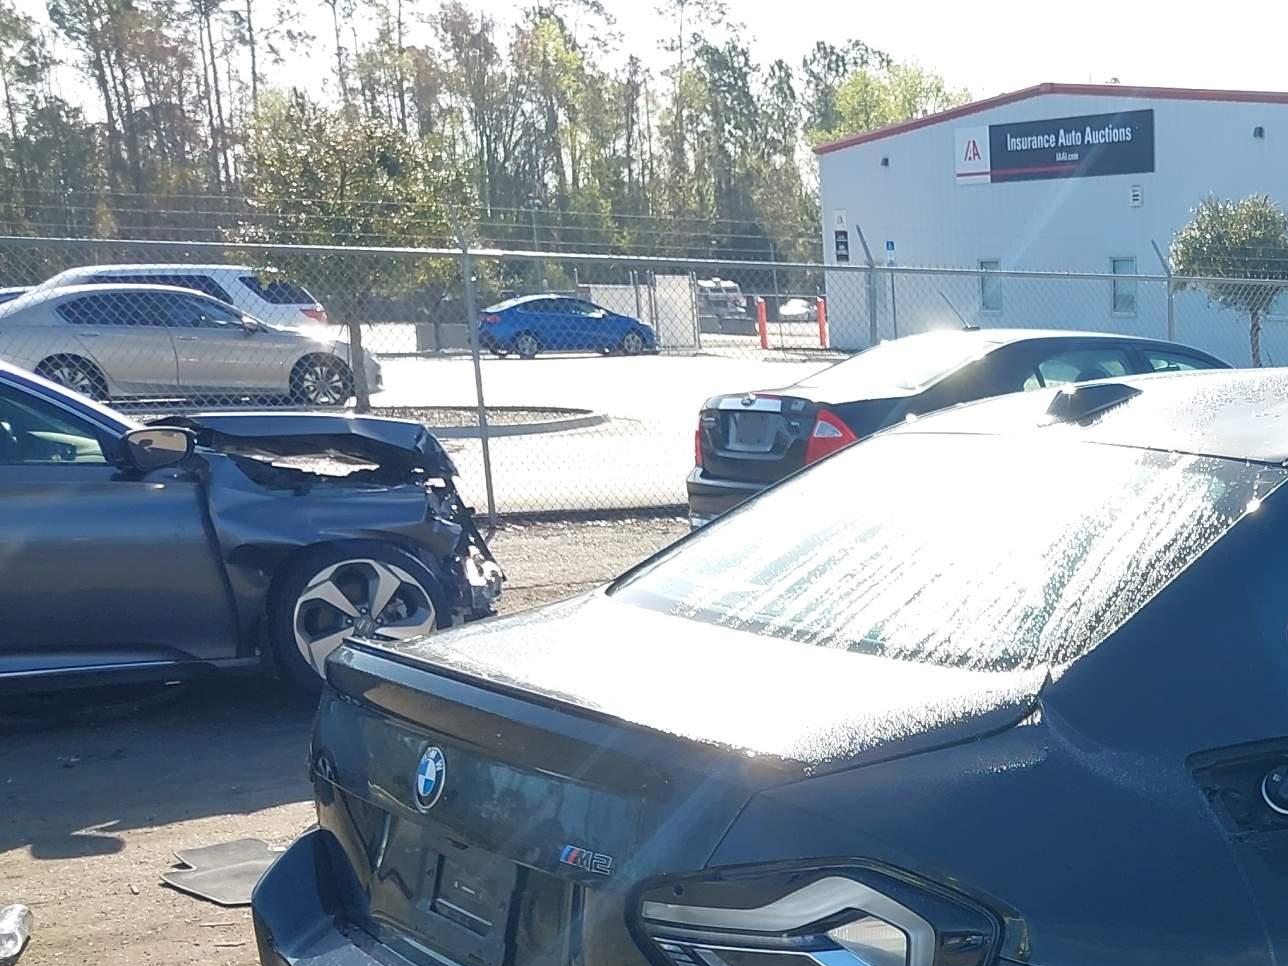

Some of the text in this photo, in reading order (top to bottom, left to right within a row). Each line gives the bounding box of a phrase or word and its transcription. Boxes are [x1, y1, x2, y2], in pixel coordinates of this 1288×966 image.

[1007, 124, 1132, 151] Insurance Auto Auctions
[562, 845, 613, 876] M2
